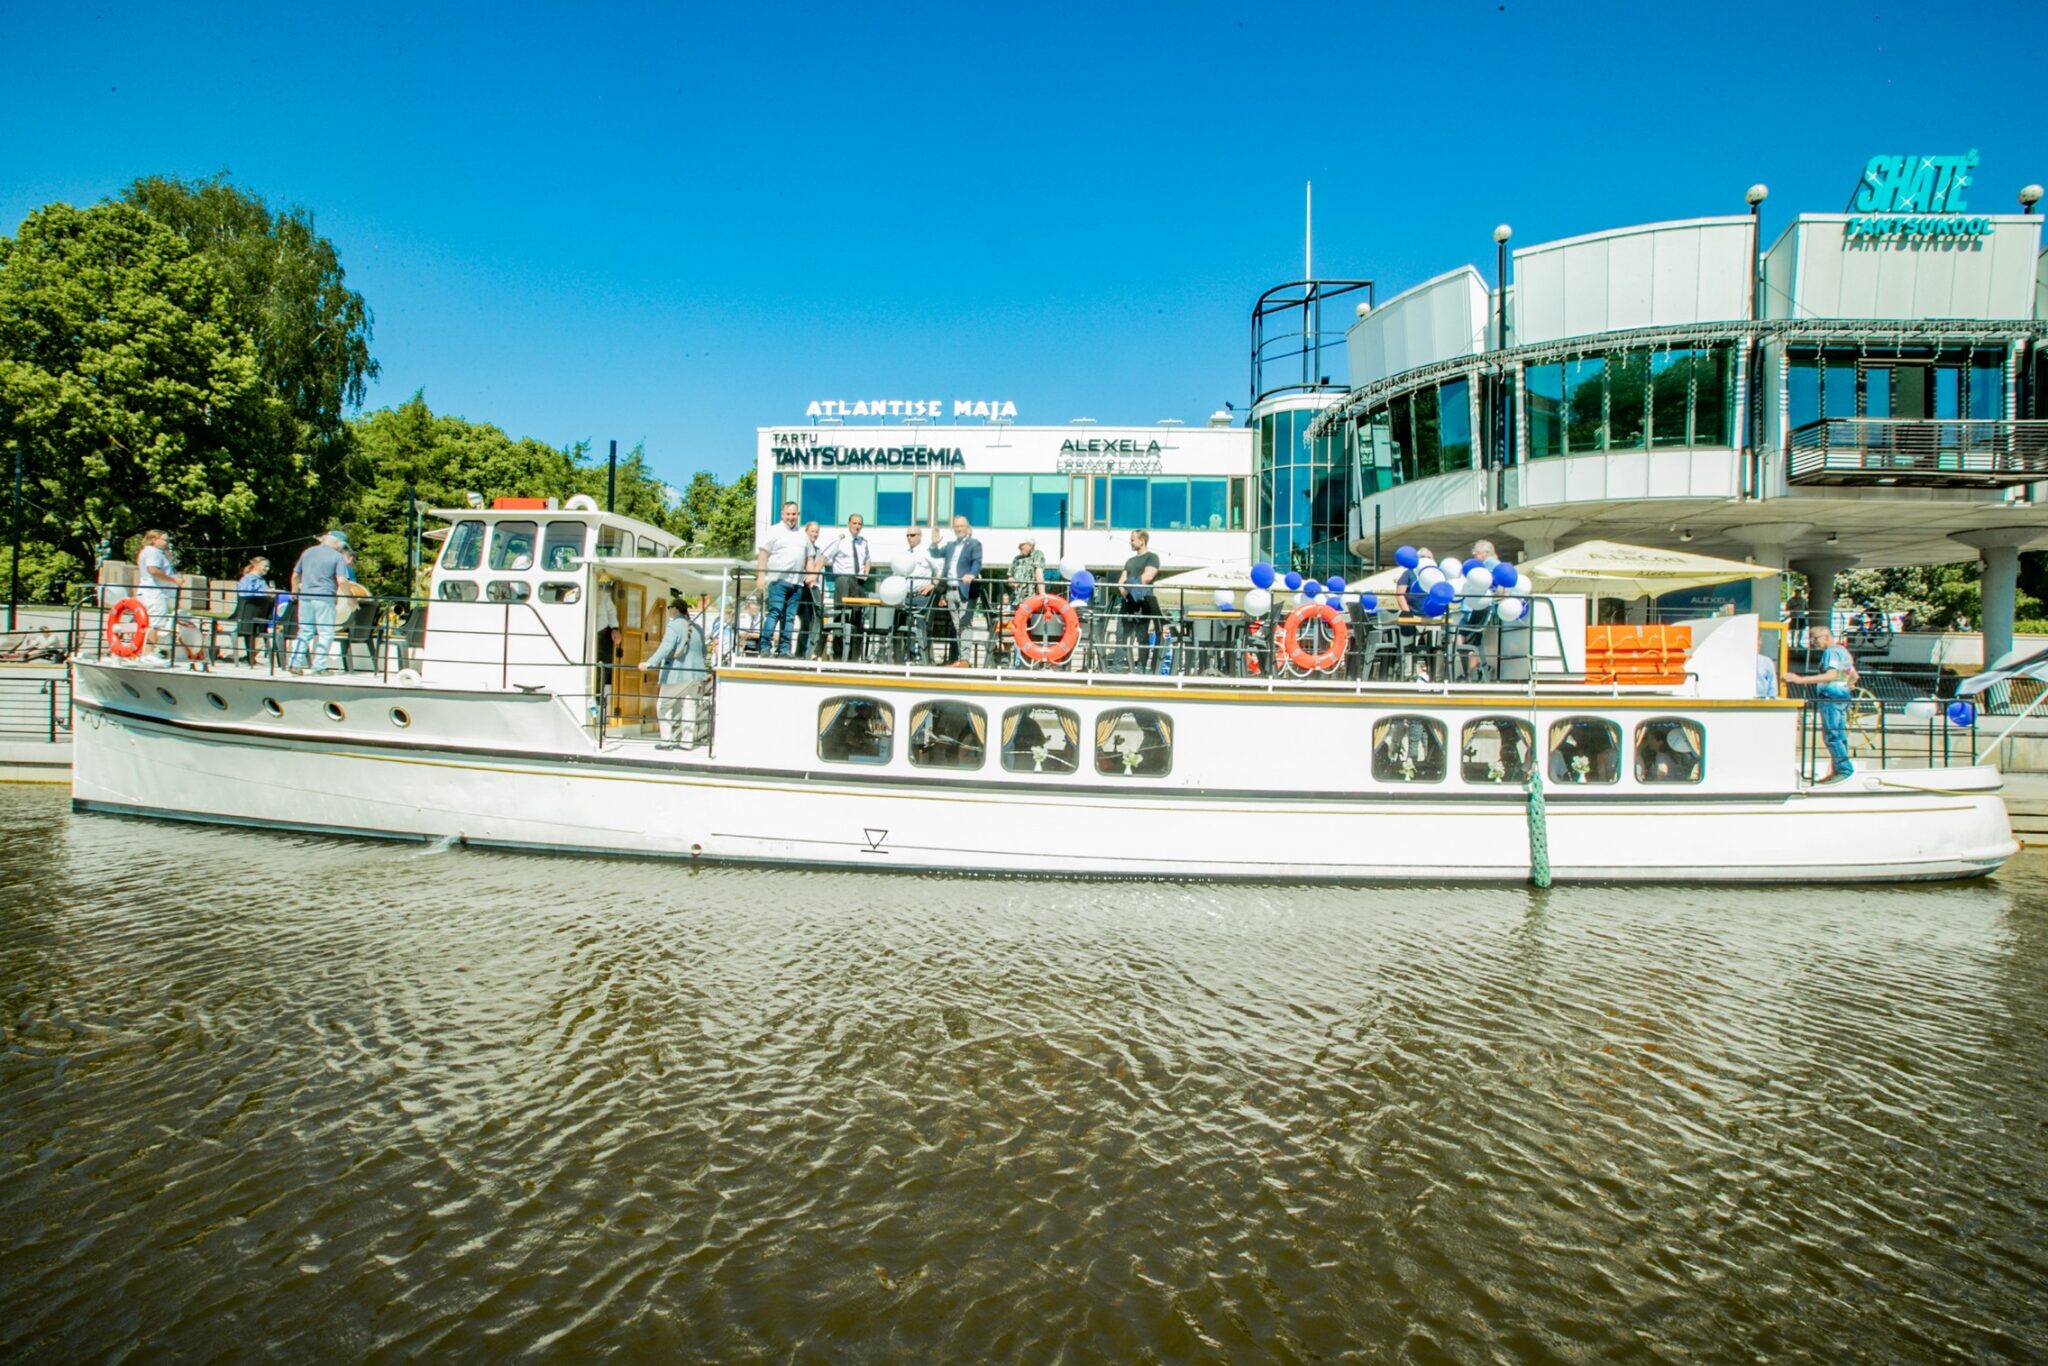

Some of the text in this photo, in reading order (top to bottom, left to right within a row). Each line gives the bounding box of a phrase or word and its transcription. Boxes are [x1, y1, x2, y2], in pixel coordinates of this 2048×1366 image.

[1854, 148, 1981, 213] SHATÉ
[1848, 216, 1996, 236] TANTSUKOOL
[805, 399, 1018, 421] ATLANTISE MAJA
[773, 432, 818, 446] TARTU
[1060, 438, 1161, 453] ALEXELA
[772, 447, 966, 468] TANTSUAKADEEMIA
